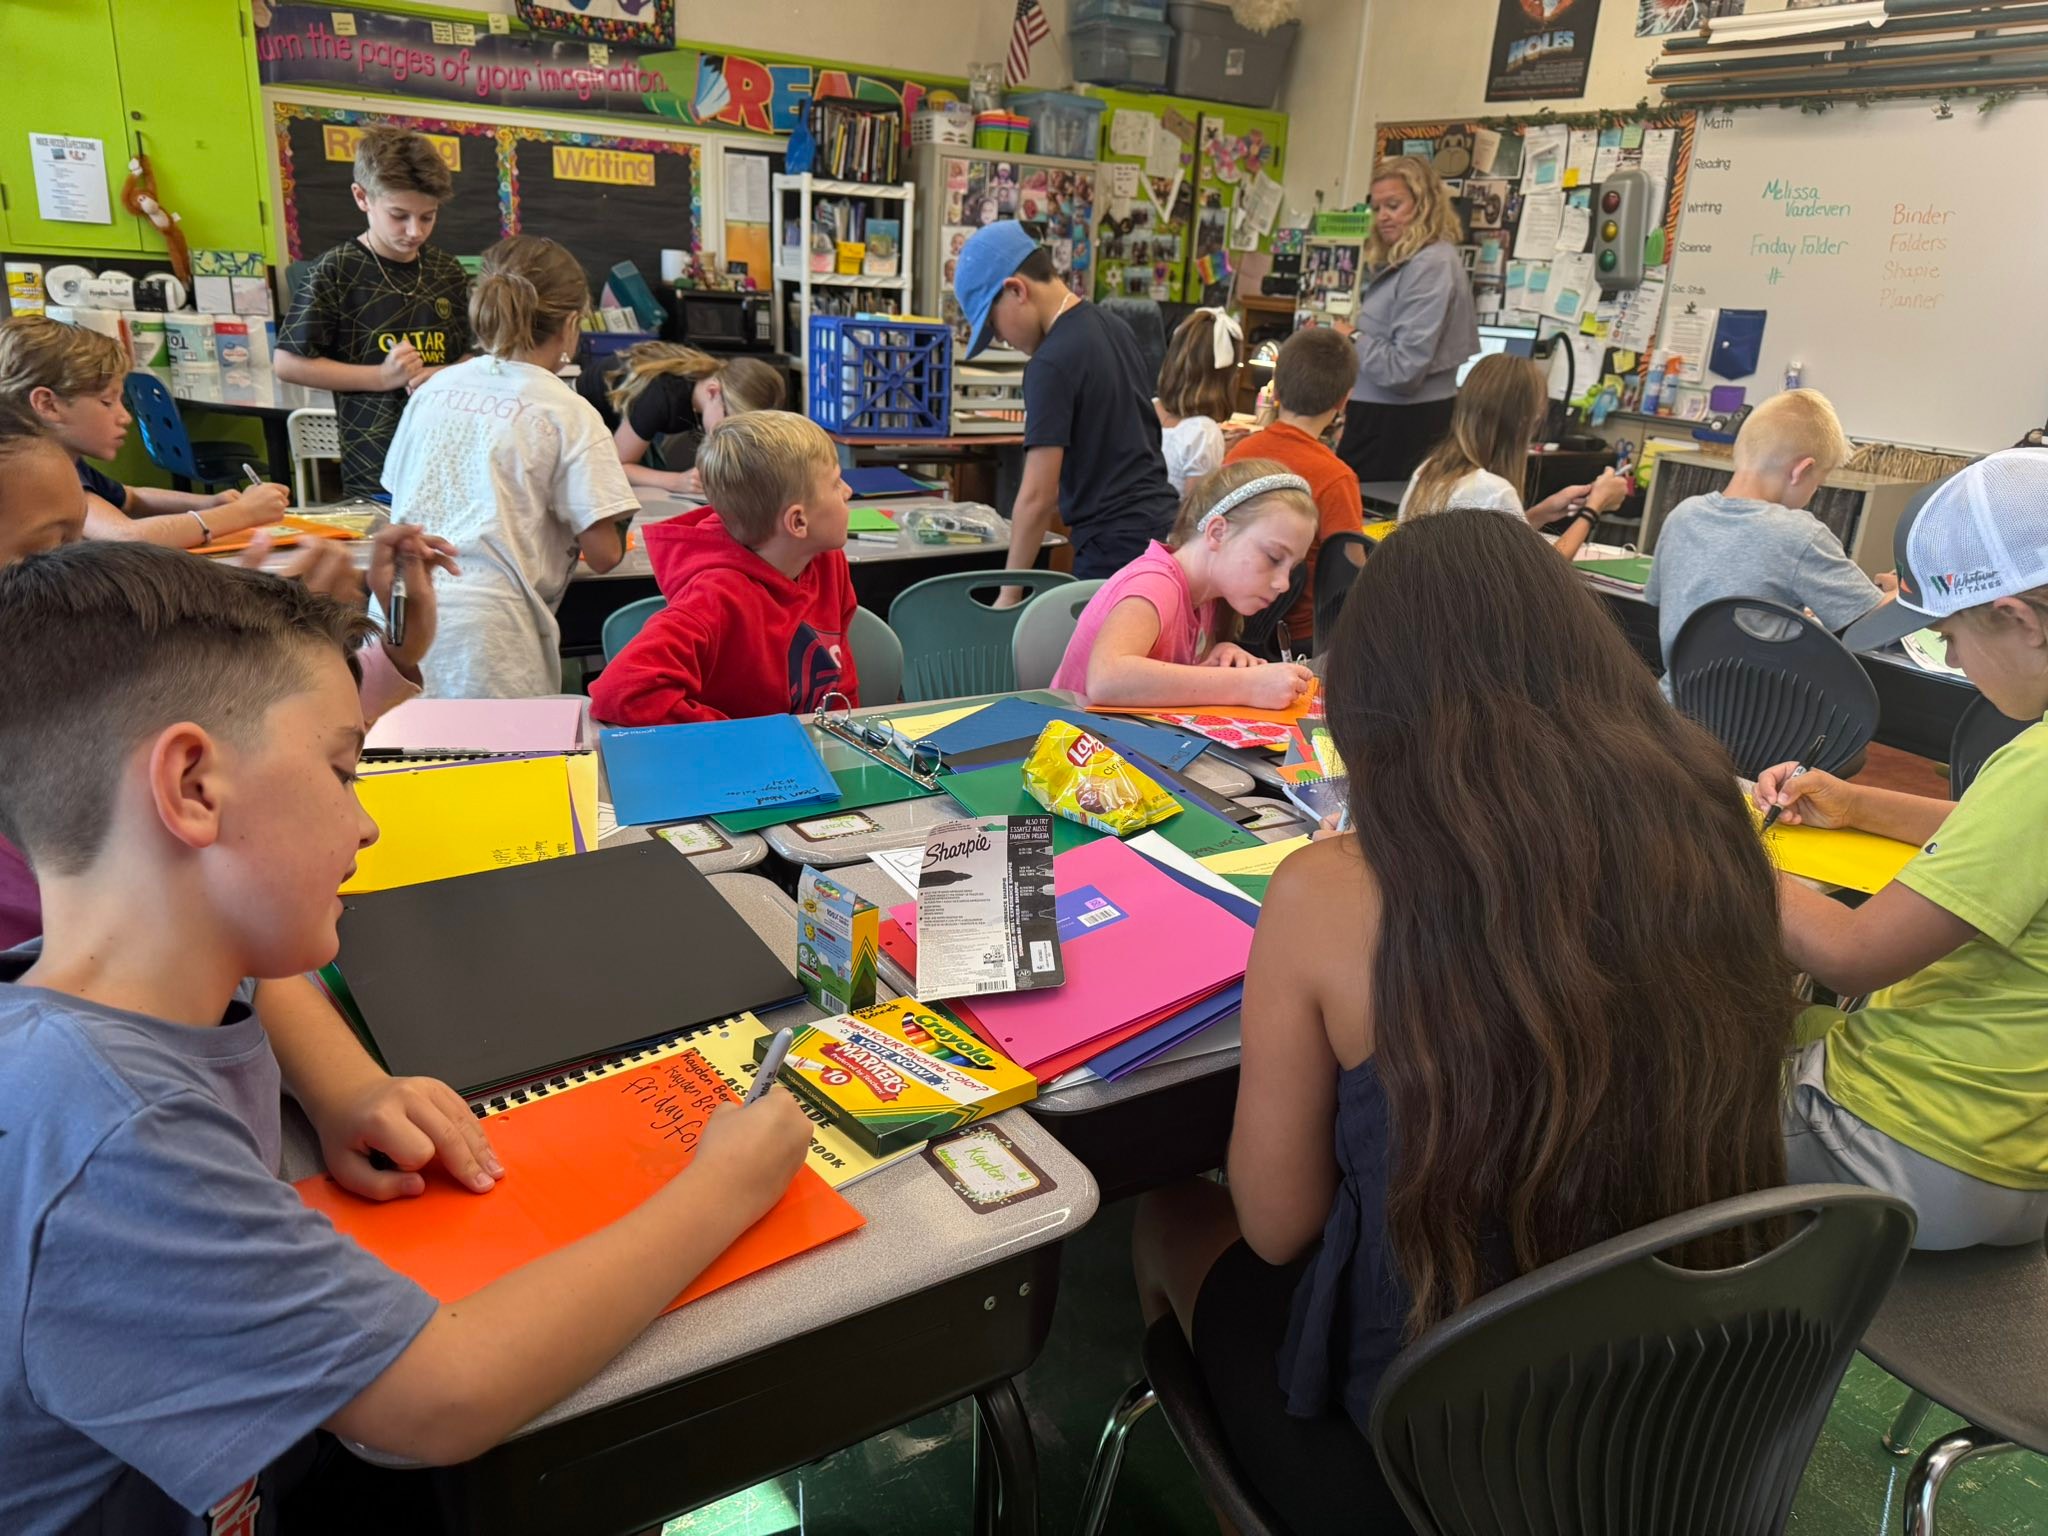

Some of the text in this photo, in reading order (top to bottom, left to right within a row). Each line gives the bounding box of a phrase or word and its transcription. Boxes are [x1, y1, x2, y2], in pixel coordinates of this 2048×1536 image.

[307, 21, 353, 60] the
[358, 39, 436, 81] pages
[441, 48, 471, 86] of
[476, 63, 532, 97] your
[535, 58, 669, 101] imagination.
[1505, 30, 1575, 72] HOLES
[1703, 116, 1734, 130] Math
[556, 149, 653, 184] Writing
[1694, 158, 1731, 171] Reading
[1762, 178, 1820, 200] Melissa
[1687, 202, 1722, 215] Writing
[1892, 202, 1956, 225] Binder
[1679, 242, 1712, 253] Science
[1750, 234, 1848, 264] Friday Folder
[1889, 233, 1947, 253] Folders
[1967, 580, 2001, 594] TAKES
[920, 833, 992, 870] Sharpie
[838, 1017, 990, 1092] What's YOUR Favorite Color?
[914, 1014, 994, 1066] Crayola
[680, 1051, 714, 1086] Kayden
[830, 1053, 857, 1072] Preferred
[862, 1071, 886, 1095] Teachers!
[834, 1042, 911, 1093] MARKERS
[858, 1038, 932, 1078] VOTE NOW!
[664, 1065, 702, 1097] Kayden
[827, 1070, 849, 1084] 10
